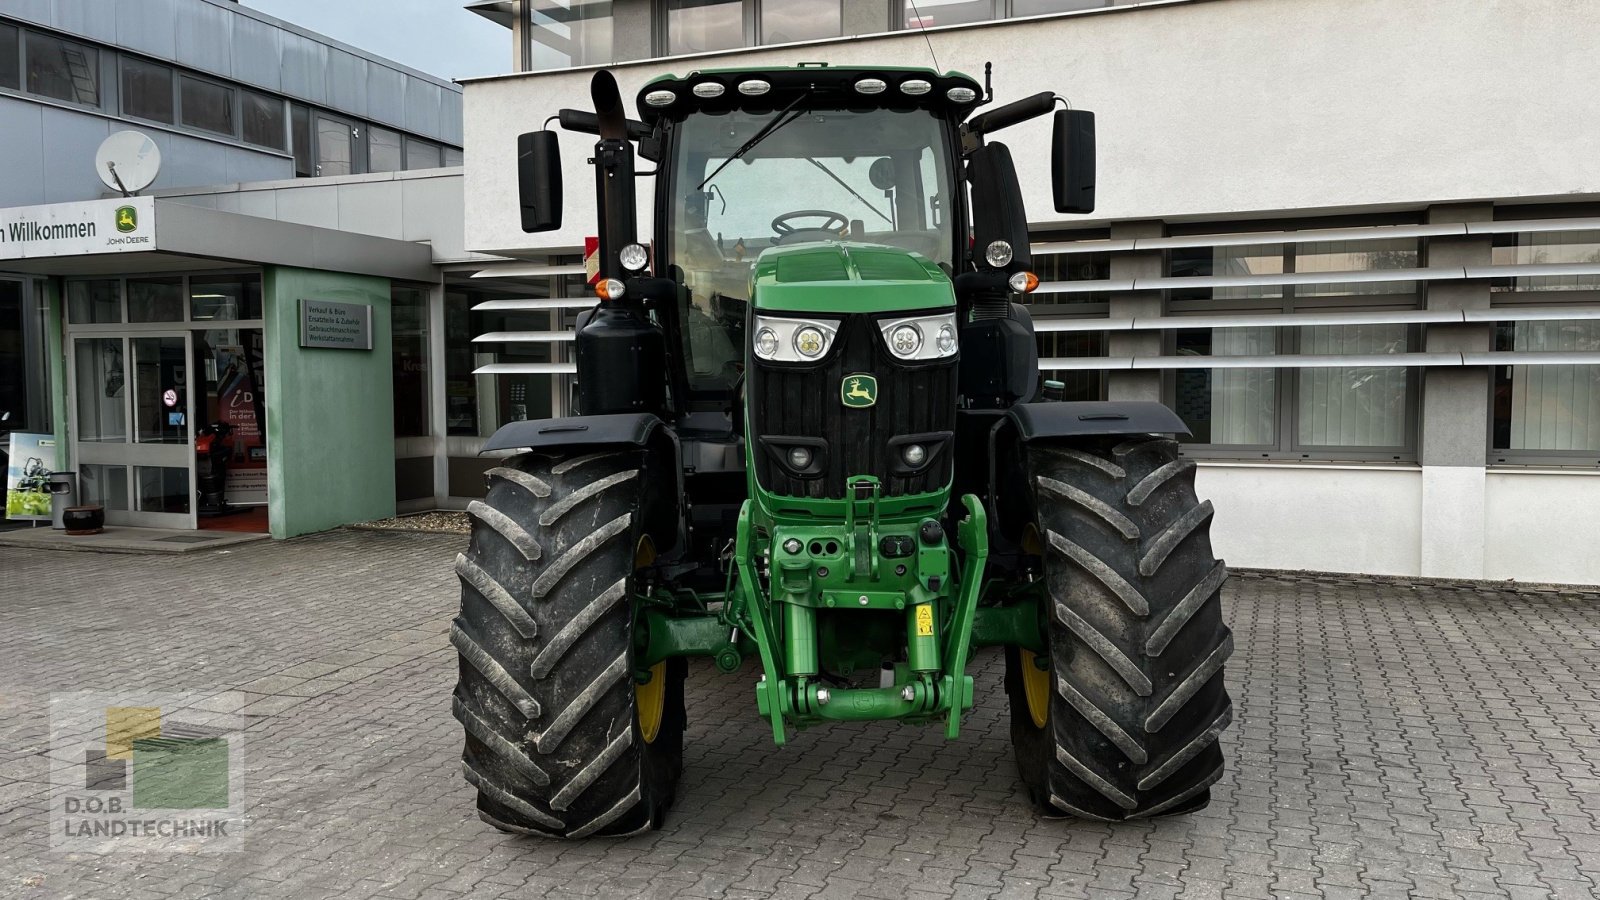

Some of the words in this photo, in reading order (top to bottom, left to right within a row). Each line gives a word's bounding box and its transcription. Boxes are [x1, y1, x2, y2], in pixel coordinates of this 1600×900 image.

[9, 221, 96, 242] Willkommen
[126, 236, 149, 244] DEERE
[309, 306, 328, 314] Verkauf
[308, 315, 335, 323] Ersatzteile
[308, 325, 360, 334] Gebrauchtmaschinen
[309, 334, 354, 342] Werkstattannahme
